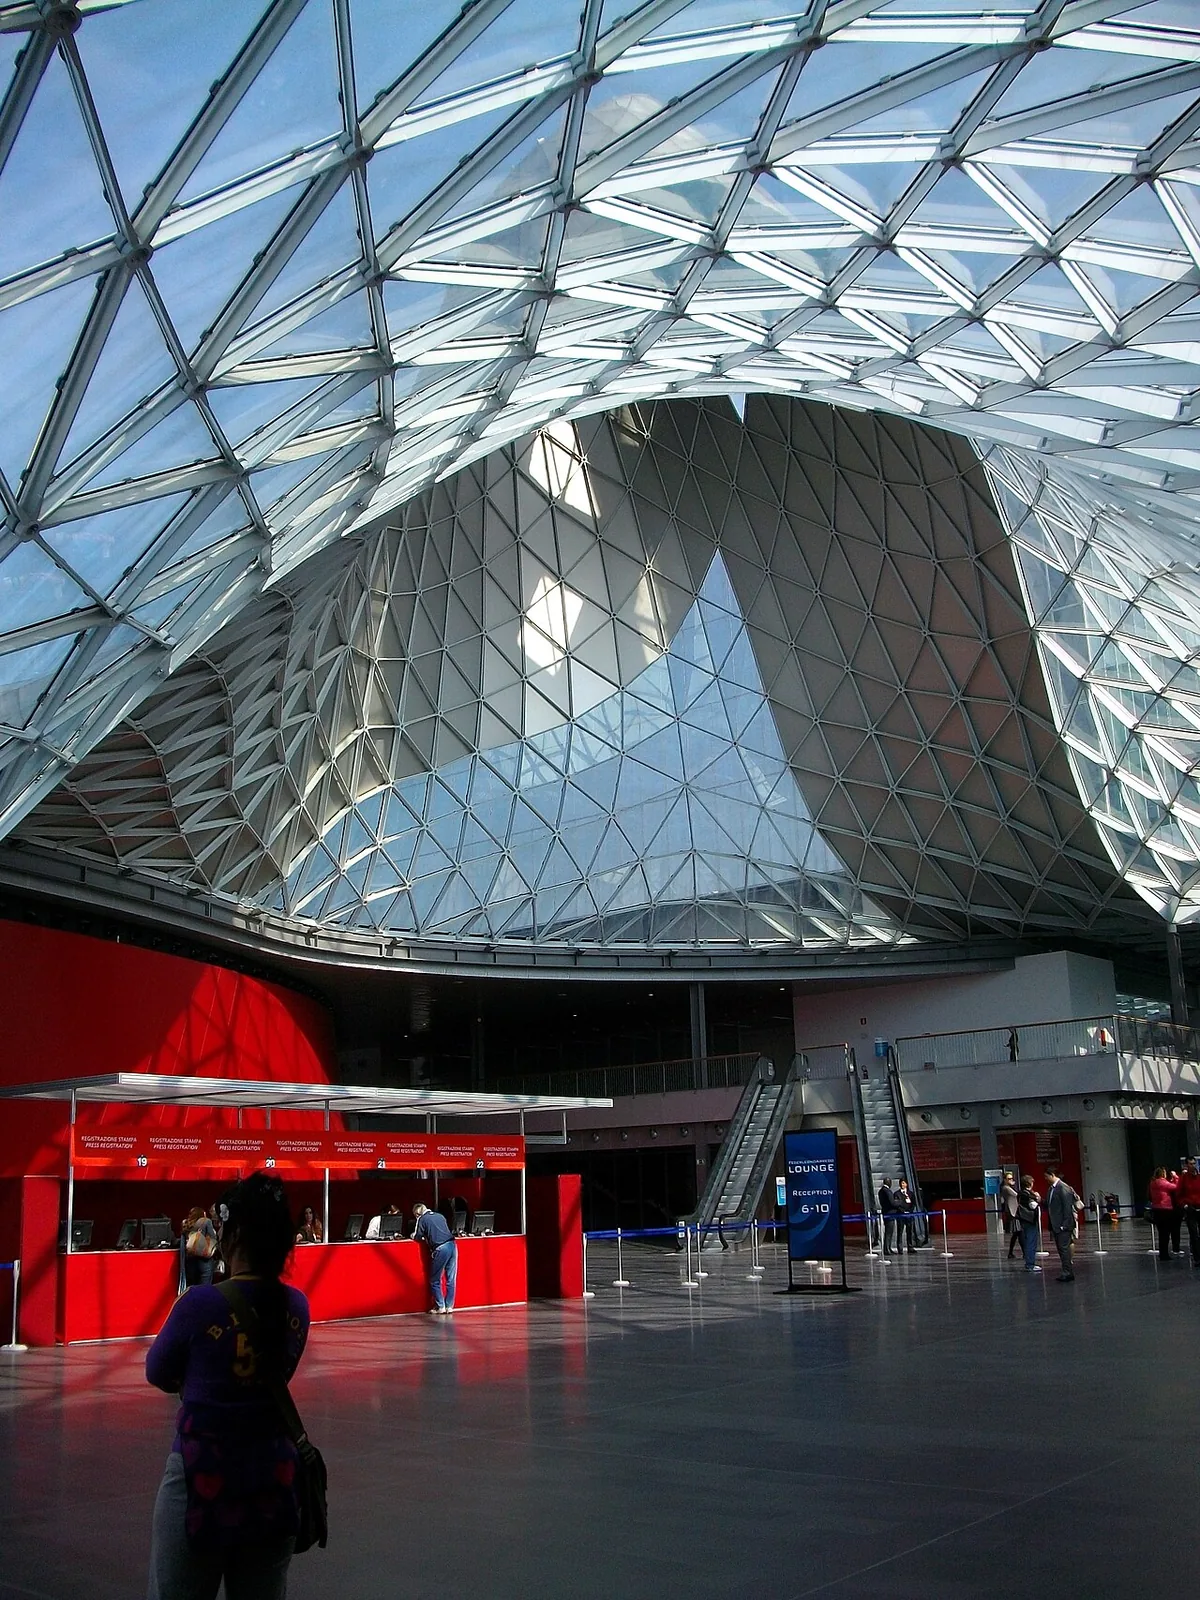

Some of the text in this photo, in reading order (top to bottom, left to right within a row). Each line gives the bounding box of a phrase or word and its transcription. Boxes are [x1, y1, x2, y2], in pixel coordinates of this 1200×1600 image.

[137, 1157, 148, 1166] 19
[265, 1159, 275, 1168] 20
[476, 1160, 484, 1169] 22
[788, 1164, 835, 1173] LOUNGE
[801, 1203, 830, 1213] 6-10
[232, 1333, 255, 1377] 5
